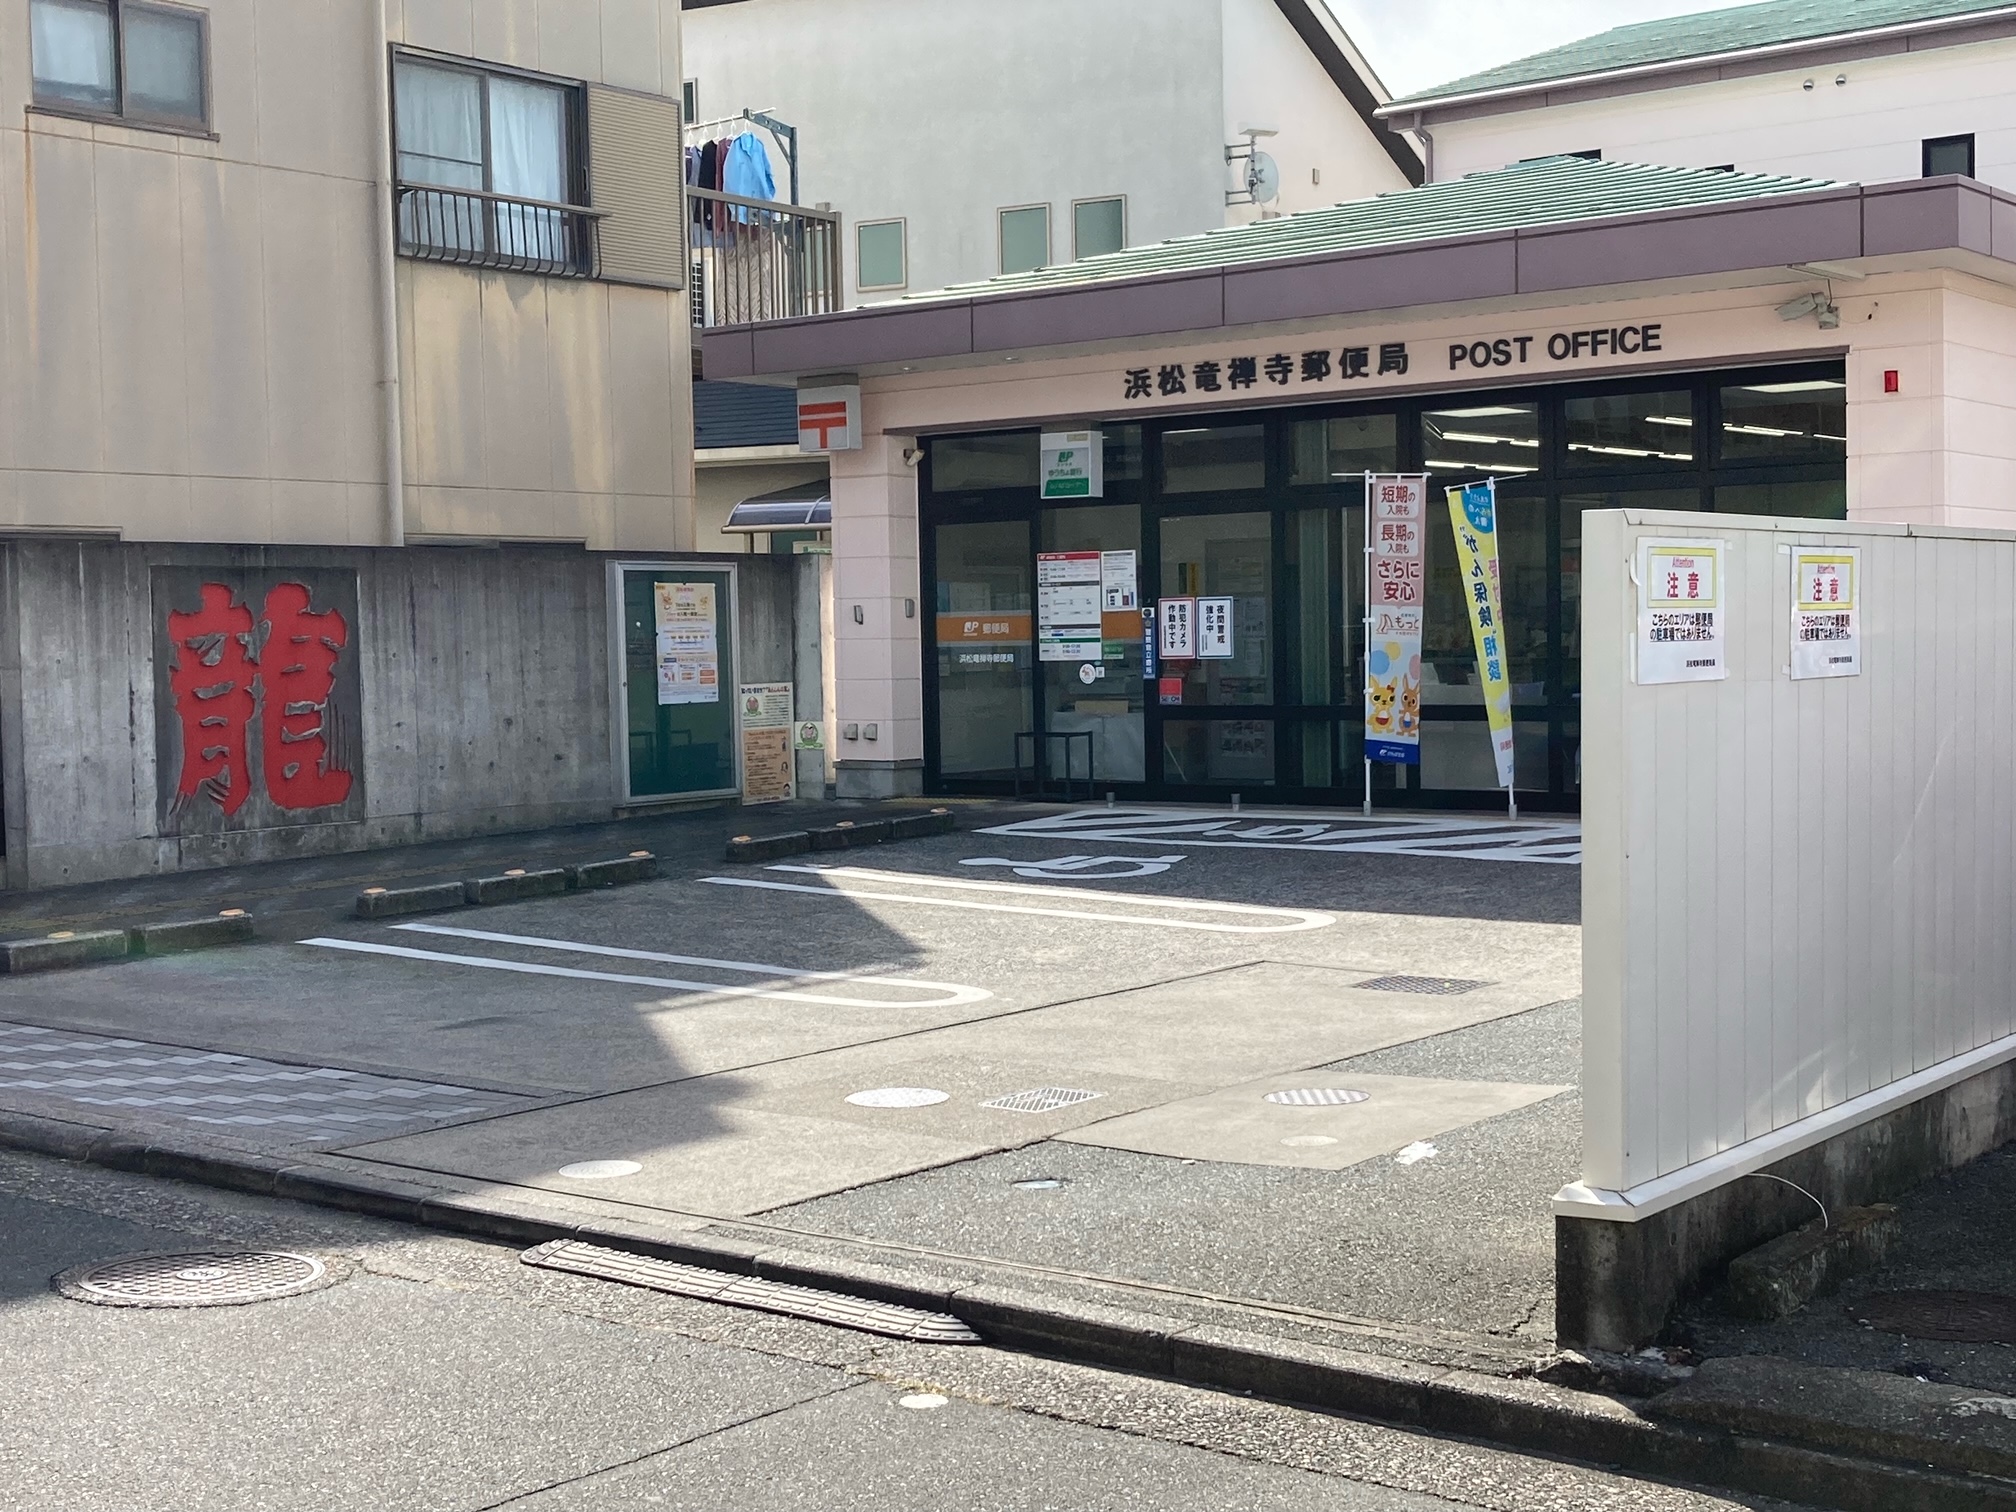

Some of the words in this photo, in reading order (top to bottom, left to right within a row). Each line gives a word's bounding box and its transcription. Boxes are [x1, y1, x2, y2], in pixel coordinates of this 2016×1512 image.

[1124, 343, 1409, 399] 浜松竜禅寺郵便局
[1449, 336, 1532, 371] POST
[1547, 324, 1662, 360] OFFICE
[1381, 485, 1415, 503] 短期の
[1387, 504, 1409, 516] 入院も
[1381, 524, 1414, 542] 長期の
[1387, 543, 1409, 554] 入院も
[1377, 560, 1420, 579] さらに
[1383, 580, 1415, 600] 安心
[1667, 571, 1699, 598] 注意
[1813, 578, 1838, 601] 注意
[982, 622, 1009, 634] 郵便局
[1168, 604, 1176, 649] 作動中です
[1178, 604, 1187, 648] 防犯カメラ
[1205, 605, 1214, 633] 強化中
[1216, 605, 1225, 644] 夜間警戒
[1395, 615, 1419, 630] もっと
[1652, 612, 1713, 627] こちらのエリアは郵便局
